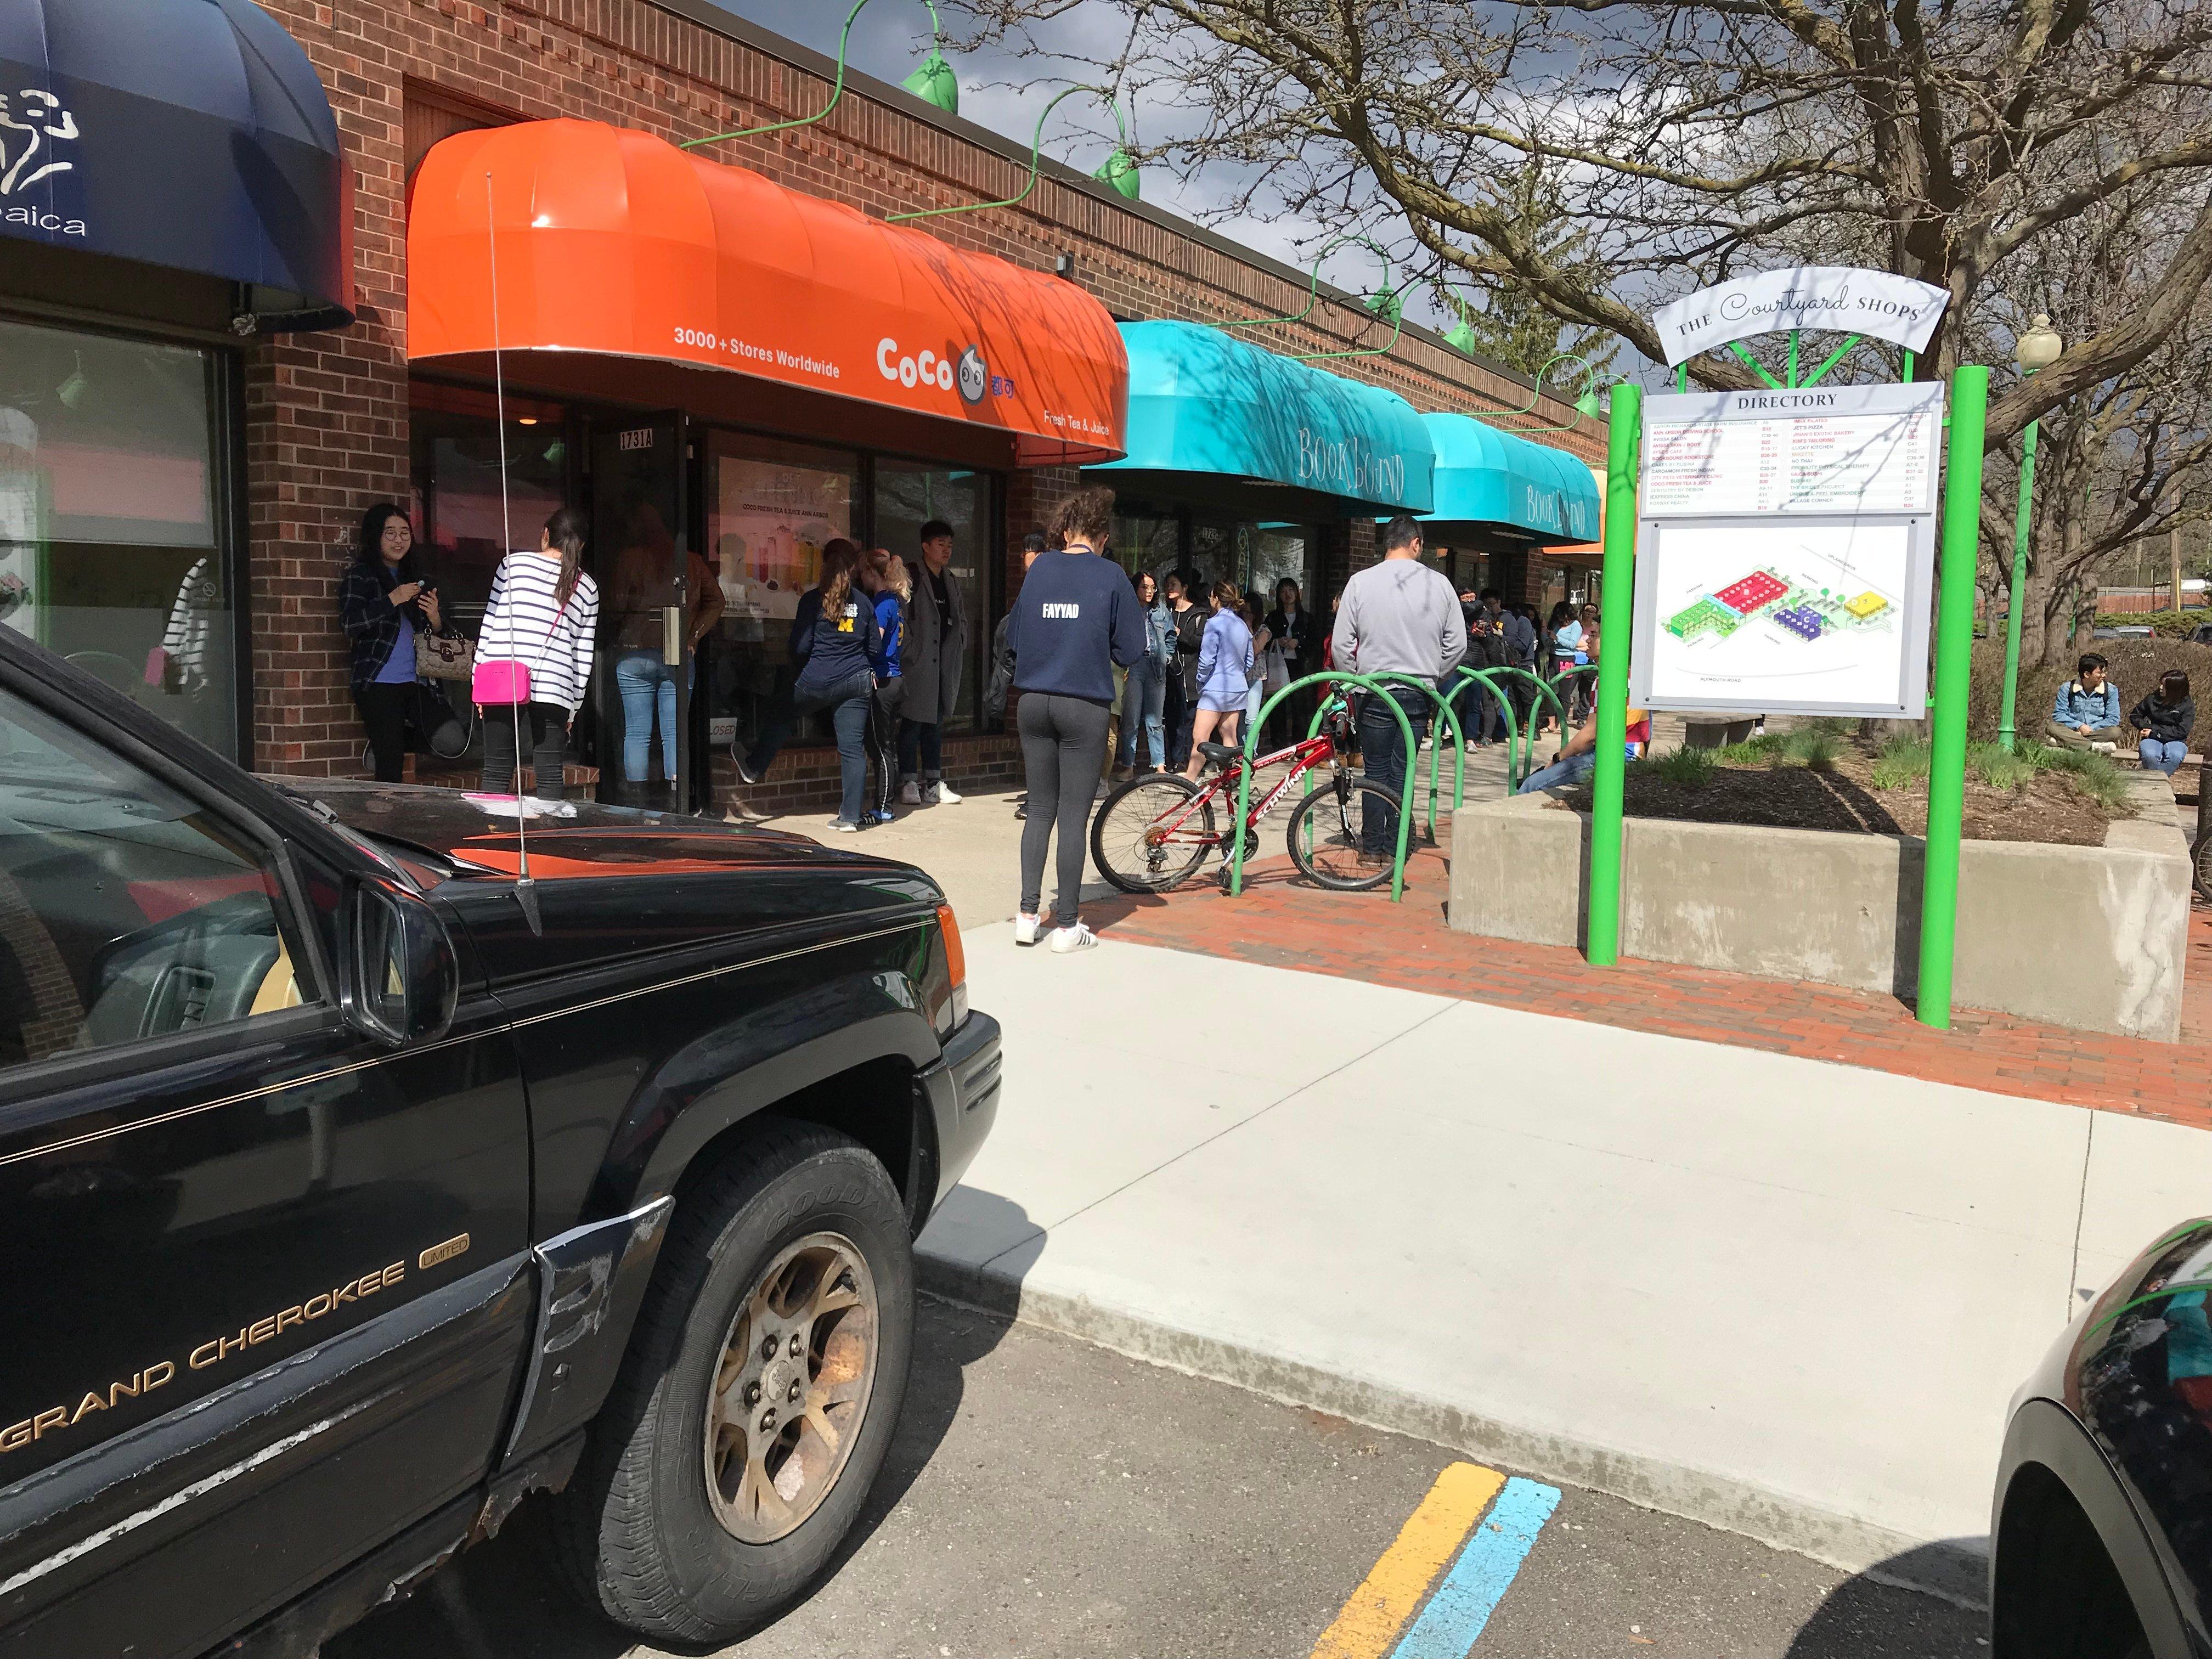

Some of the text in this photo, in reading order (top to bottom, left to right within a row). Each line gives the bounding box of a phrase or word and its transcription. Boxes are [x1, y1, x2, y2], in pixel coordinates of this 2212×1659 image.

[0, 205, 85, 236] aica
[1677, 285, 1921, 336] THE Courtyard SHOPS
[674, 327, 716, 349] 3000
[730, 338, 773, 363] Stores
[776, 349, 839, 379] Worldwide
[877, 337, 953, 391] CoCo
[1737, 393, 1838, 409] DIRECTORY
[1044, 410, 1109, 435] Fresh Tea & Juice
[622, 430, 652, 449] 1731A
[1827, 554, 1857, 571] UPLAND DRIVE
[1801, 573, 1819, 584] PARKING
[1686, 583, 1703, 594] PARKING
[1042, 603, 1079, 619] FAYYAD
[838, 618, 854, 632] M
[1687, 637, 1704, 648] PARKING
[1764, 634, 1781, 645] PARKING
[1256, 765, 1307, 821] SCHWINN
[424, 1239, 468, 1266] LIMITED
[0, 1260, 405, 1453] GRAND CHEROKEE
